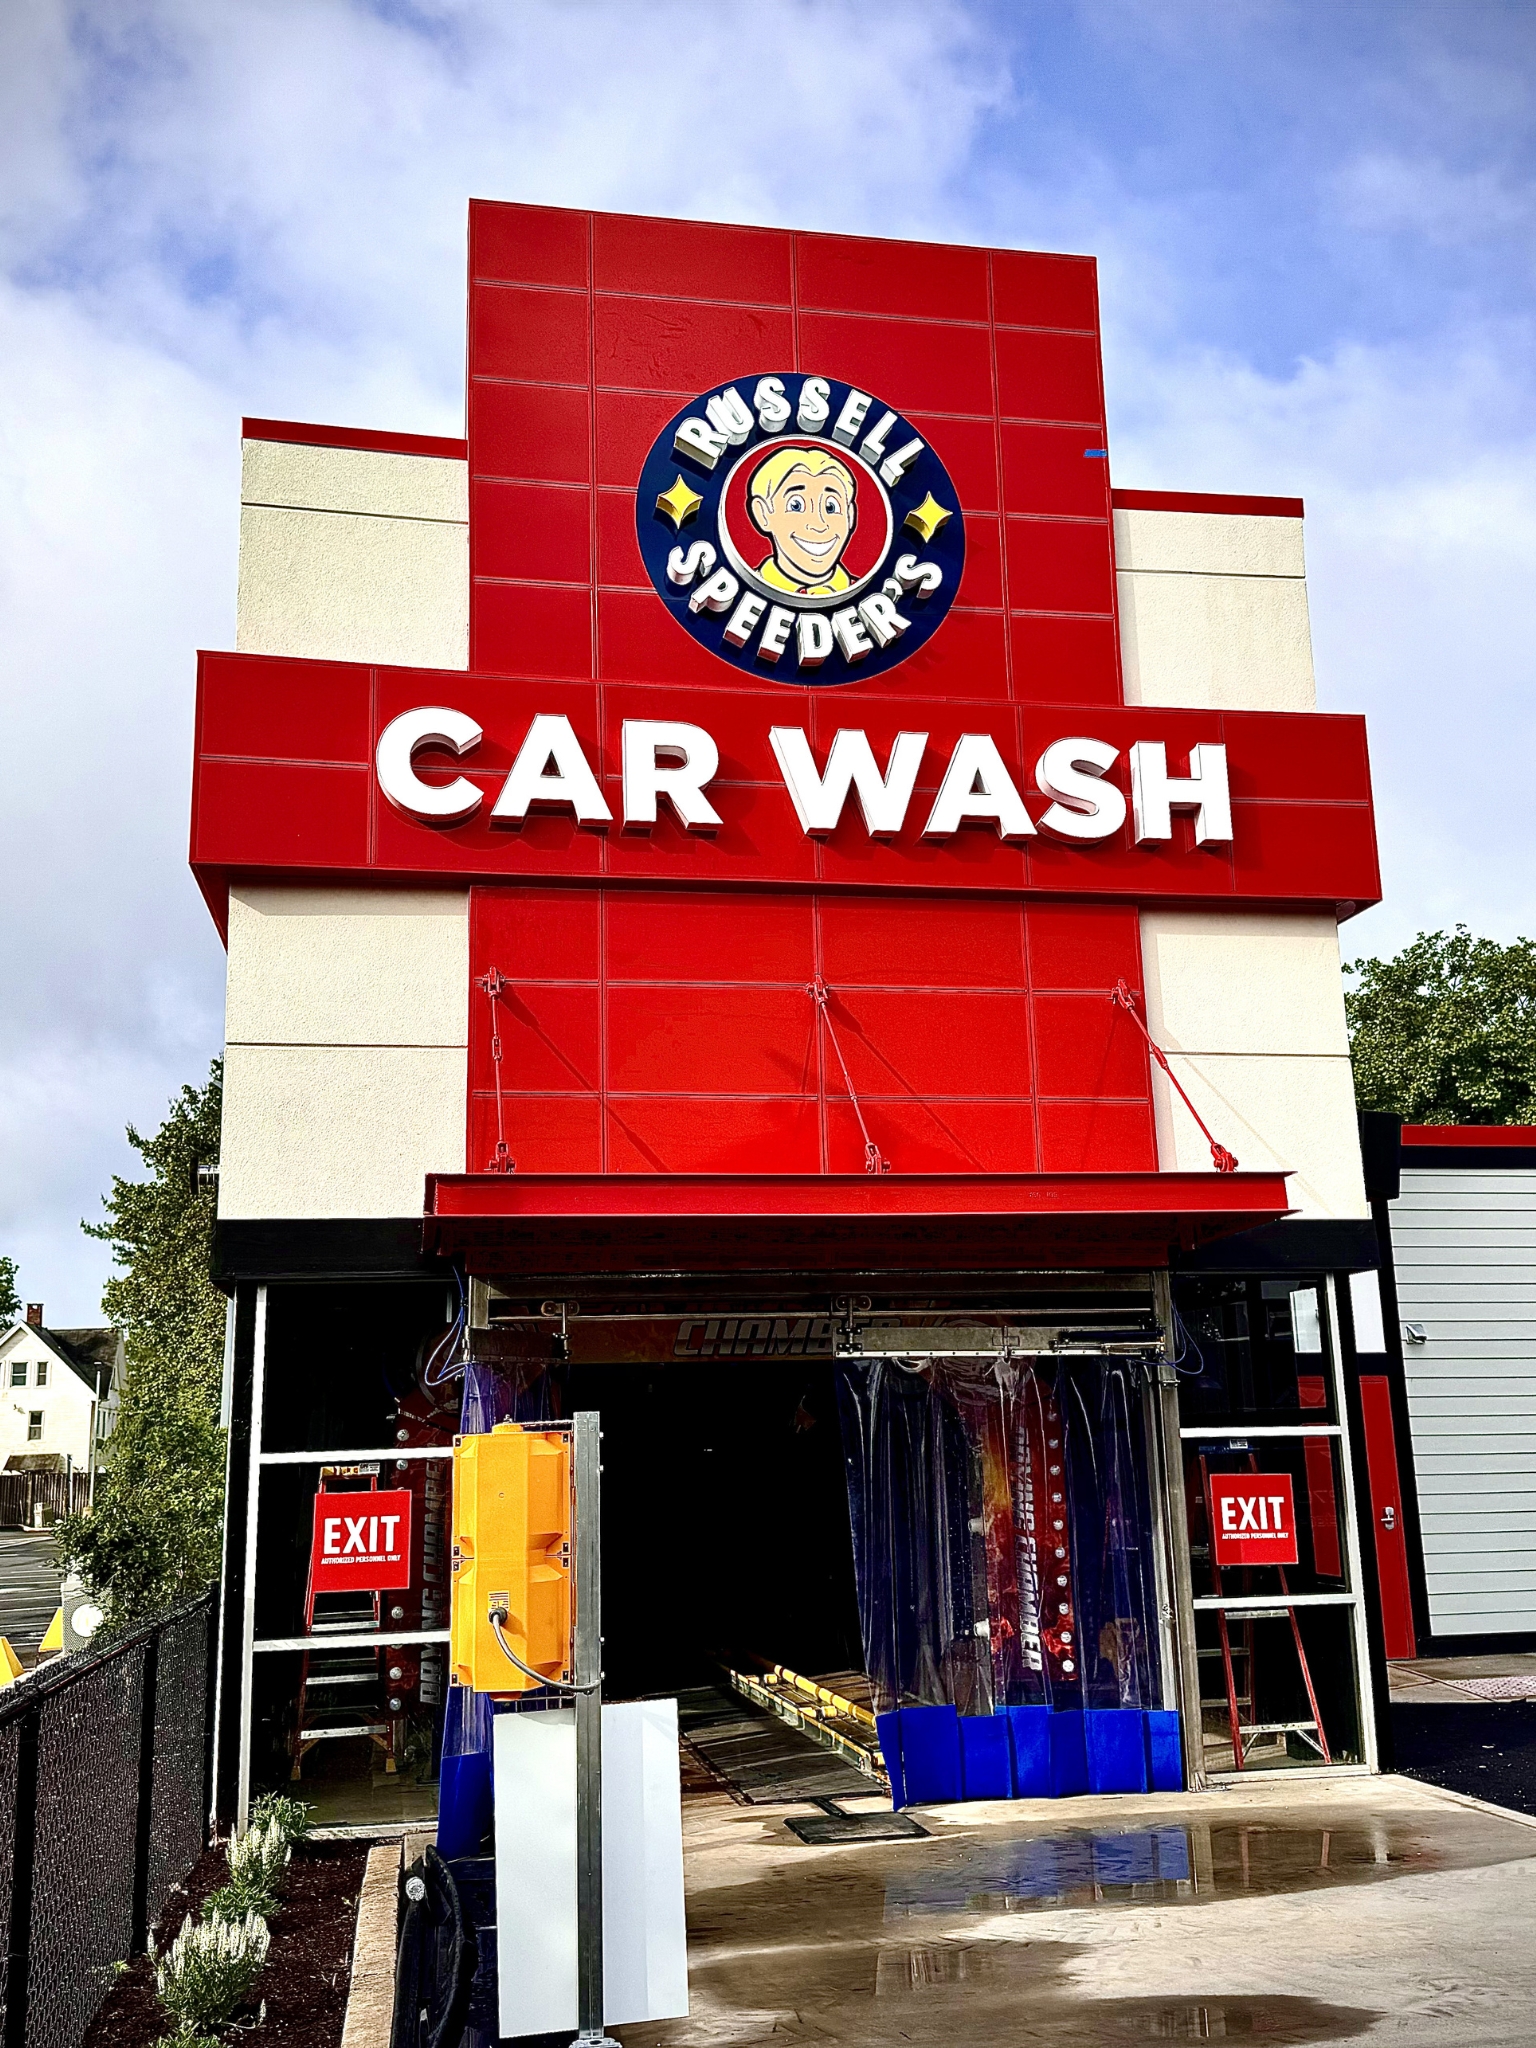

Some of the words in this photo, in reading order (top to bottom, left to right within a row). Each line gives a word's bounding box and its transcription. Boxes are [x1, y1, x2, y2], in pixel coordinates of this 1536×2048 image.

[674, 376, 925, 487] RUSSELL
[667, 540, 943, 667] SPEEDER'S
[375, 705, 724, 833] CAR
[769, 725, 1233, 846] WASH
[673, 1318, 901, 1356] CHAMB
[320, 1556, 355, 1565] AUTHORIZED
[355, 1555, 386, 1563] PERSONNEL
[387, 1554, 401, 1562] ONLY
[323, 1515, 401, 1555] EXIT
[423, 1442, 445, 1582] CHAMBE
[1220, 1496, 1285, 1531] EXIT
[419, 1588, 443, 1704] DRYNG
[1015, 1534, 1044, 1672] CHAMBER
